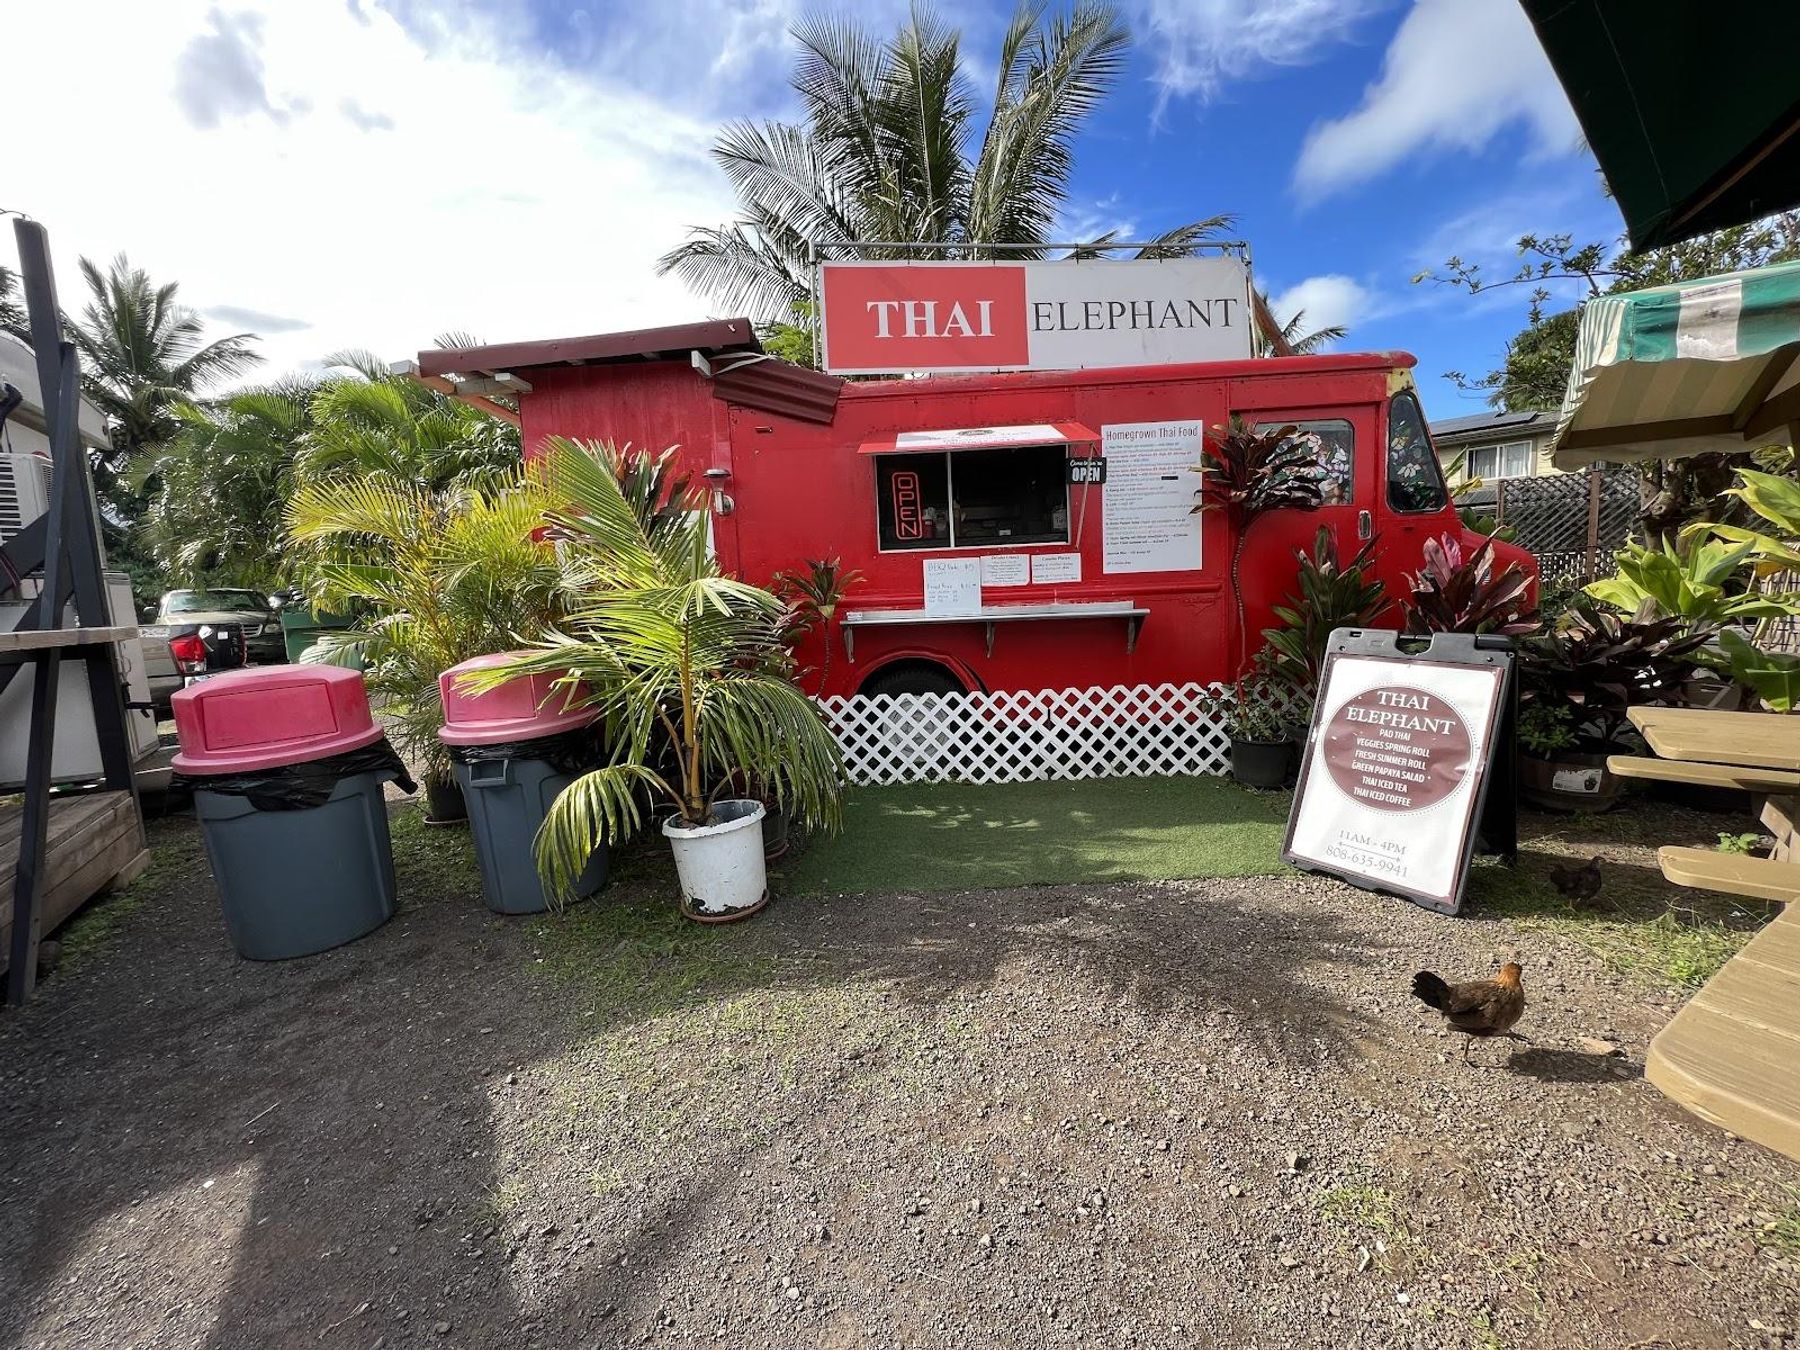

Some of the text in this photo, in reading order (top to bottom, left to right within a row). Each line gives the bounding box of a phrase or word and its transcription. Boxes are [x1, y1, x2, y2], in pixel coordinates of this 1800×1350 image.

[866, 298, 1238, 339] THAI ELEPHANT
[1106, 426, 1198, 441] Homegrown Thai Food
[1072, 466, 1101, 482] OPEN
[897, 476, 918, 536] OPEN
[1377, 691, 1430, 711] THAI
[1346, 706, 1456, 736] ELEPHANT
[1379, 729, 1411, 741] PAD THAI
[1356, 737, 1430, 758] VEGGIES SPRING ROLL
[1355, 750, 1426, 771] FRESH SUMMER ROLL
[1351, 761, 1425, 783] GREEN PAPAYA SALAD
[1362, 776, 1408, 793] THAI ICED TEA
[1353, 786, 1412, 807] THAI ICED COFFEE
[1339, 830, 1370, 846] 11AM
[1380, 841, 1407, 855] 4PM
[1326, 844, 1408, 878] 808-635-9941
